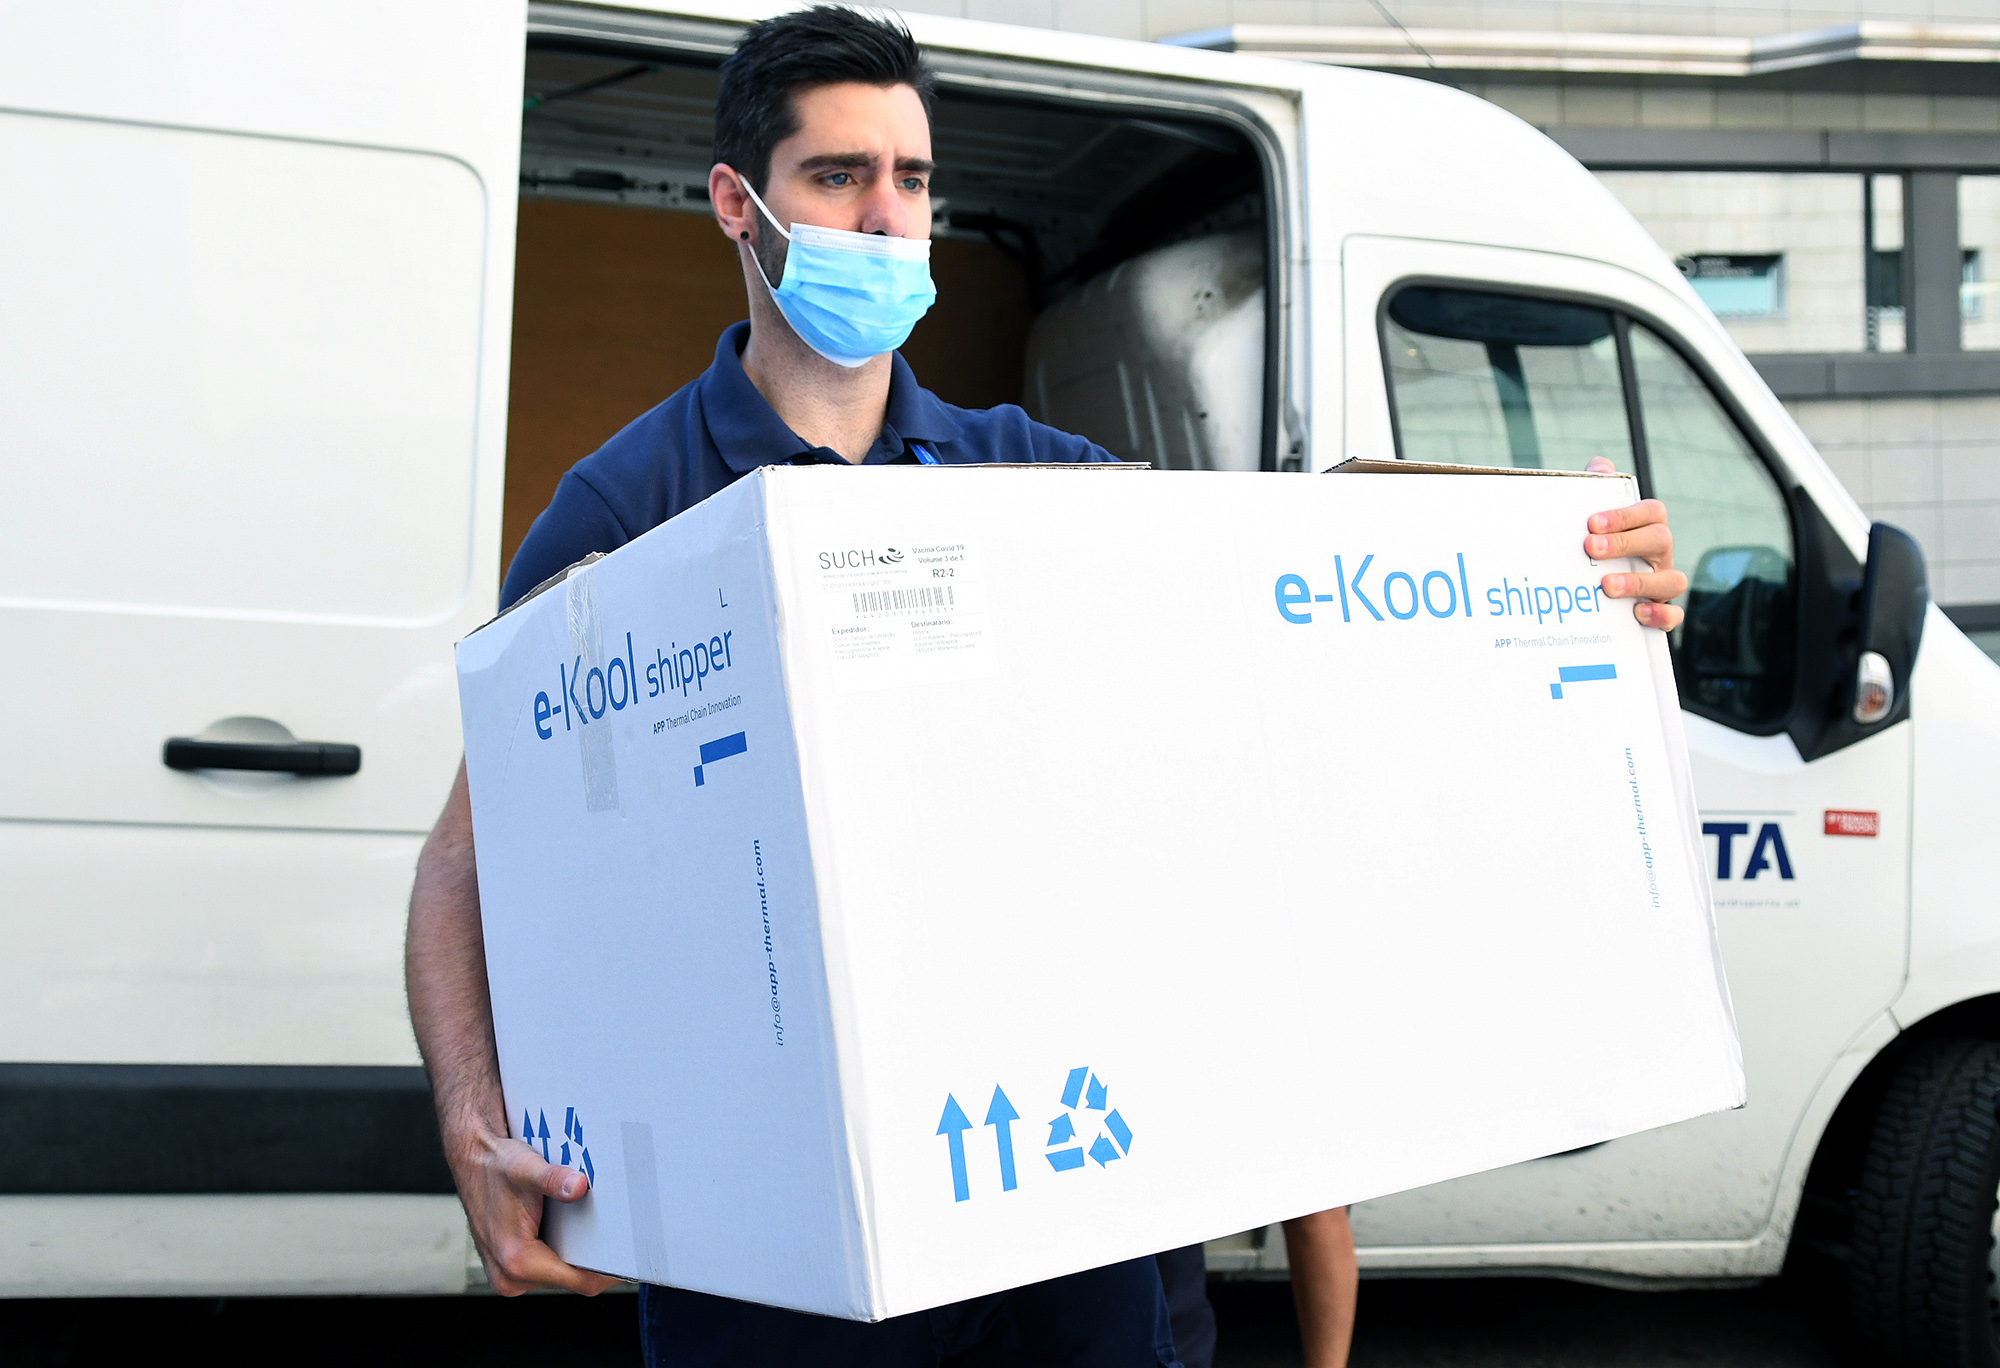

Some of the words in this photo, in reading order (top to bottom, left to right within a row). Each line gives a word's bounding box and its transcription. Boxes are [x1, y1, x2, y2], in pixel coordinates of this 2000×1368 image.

[818, 549, 876, 570] SUCH
[918, 555, 943, 564] Volume
[935, 545, 955, 553] Covid
[956, 544, 965, 552] 19
[932, 568, 955, 579] R2-2
[718, 587, 728, 609] L
[1274, 552, 1473, 625] e-Kool
[1486, 576, 1602, 624] shipper
[1494, 638, 1512, 648] APP
[1513, 637, 1547, 648] Thermal
[1547, 636, 1570, 647] Chain
[1570, 634, 1612, 645] Innovation
[533, 631, 639, 740] e-Kool
[645, 629, 732, 698] shipper
[653, 719, 666, 735] APP
[666, 709, 691, 730] Thermal
[690, 704, 708, 721] Chain
[708, 694, 742, 715] Innovation
[1624, 747, 1661, 909] info@app-thermal.com
[753, 838, 784, 1047] info@app-thermal.com
